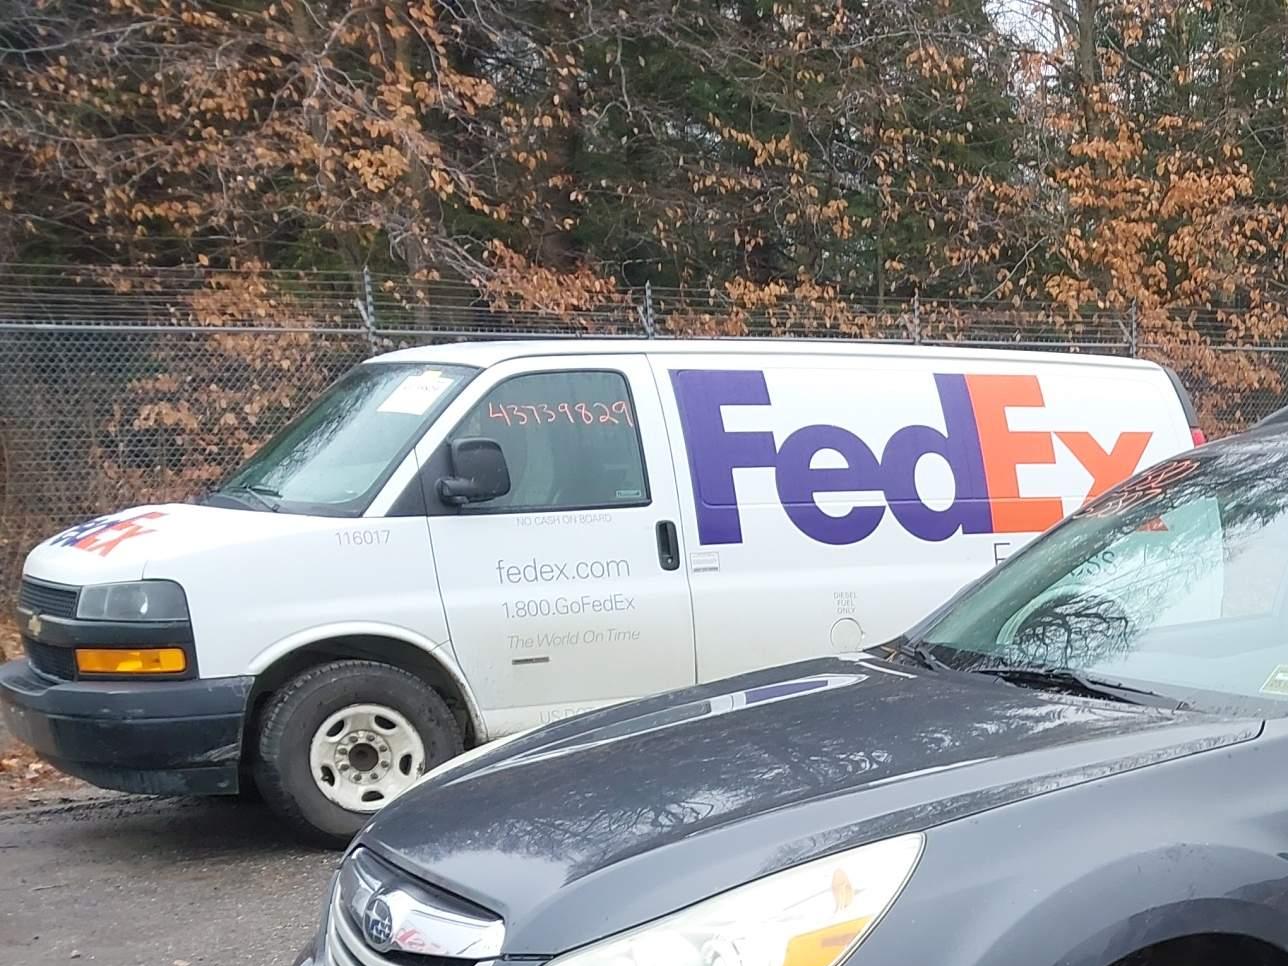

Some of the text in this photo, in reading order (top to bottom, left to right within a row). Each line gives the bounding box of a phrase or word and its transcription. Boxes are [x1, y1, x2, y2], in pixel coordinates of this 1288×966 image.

[489, 401, 634, 428] 43739829
[668, 369, 1168, 545] FedEx
[516, 513, 613, 526] NO CASH ON BOARD
[335, 529, 391, 546] 116017
[496, 558, 631, 585] fedex.com
[833, 591, 858, 599] DIESEL
[837, 599, 856, 607] FUEL
[501, 593, 636, 620] 1.800.GoFedEx
[837, 607, 856, 615] ONLY
[508, 628, 641, 648] The World On Time
